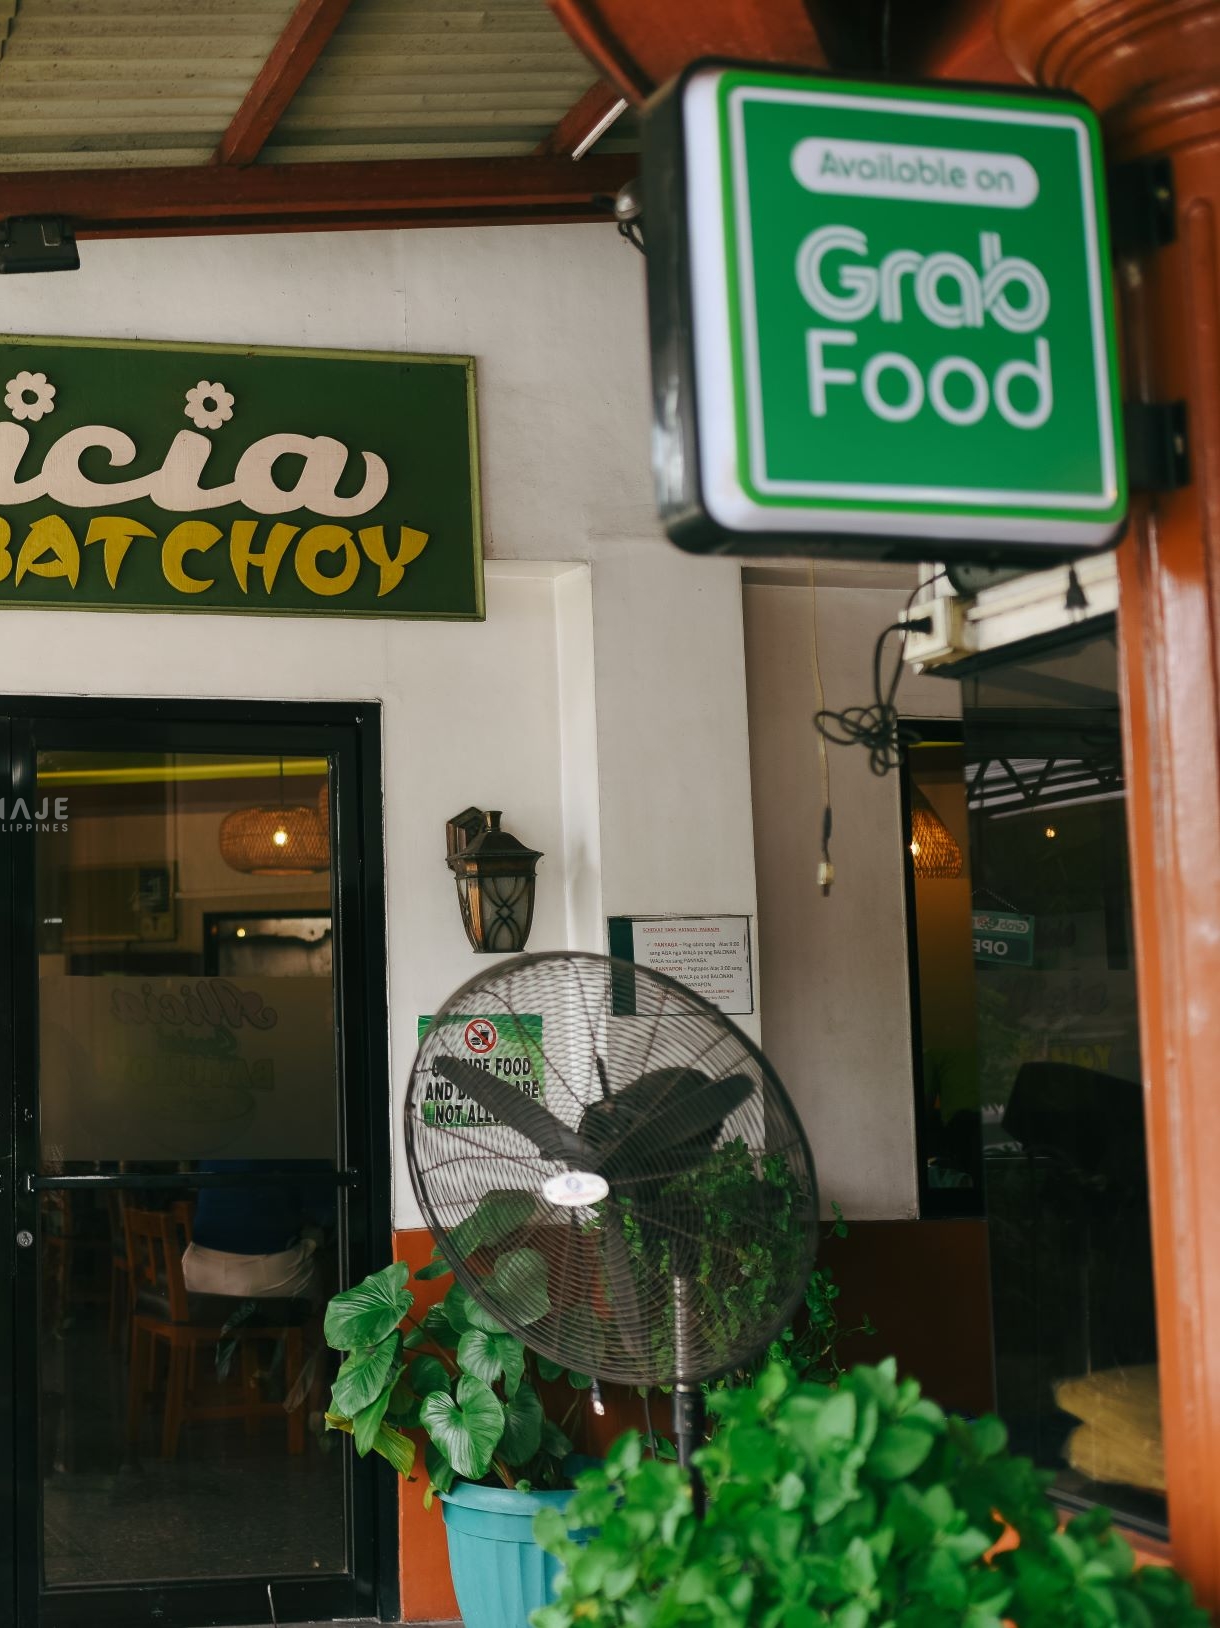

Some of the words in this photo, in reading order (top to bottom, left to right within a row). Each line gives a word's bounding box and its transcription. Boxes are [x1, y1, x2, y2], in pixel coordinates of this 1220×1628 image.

[819, 150, 967, 190] Available
[974, 165, 1015, 193] on
[794, 223, 1051, 334] Grab
[804, 328, 1054, 430] Food
[496, 1057, 531, 1076] FOOD
[425, 1082, 454, 1101] AND
[435, 1104, 463, 1124] NOT
